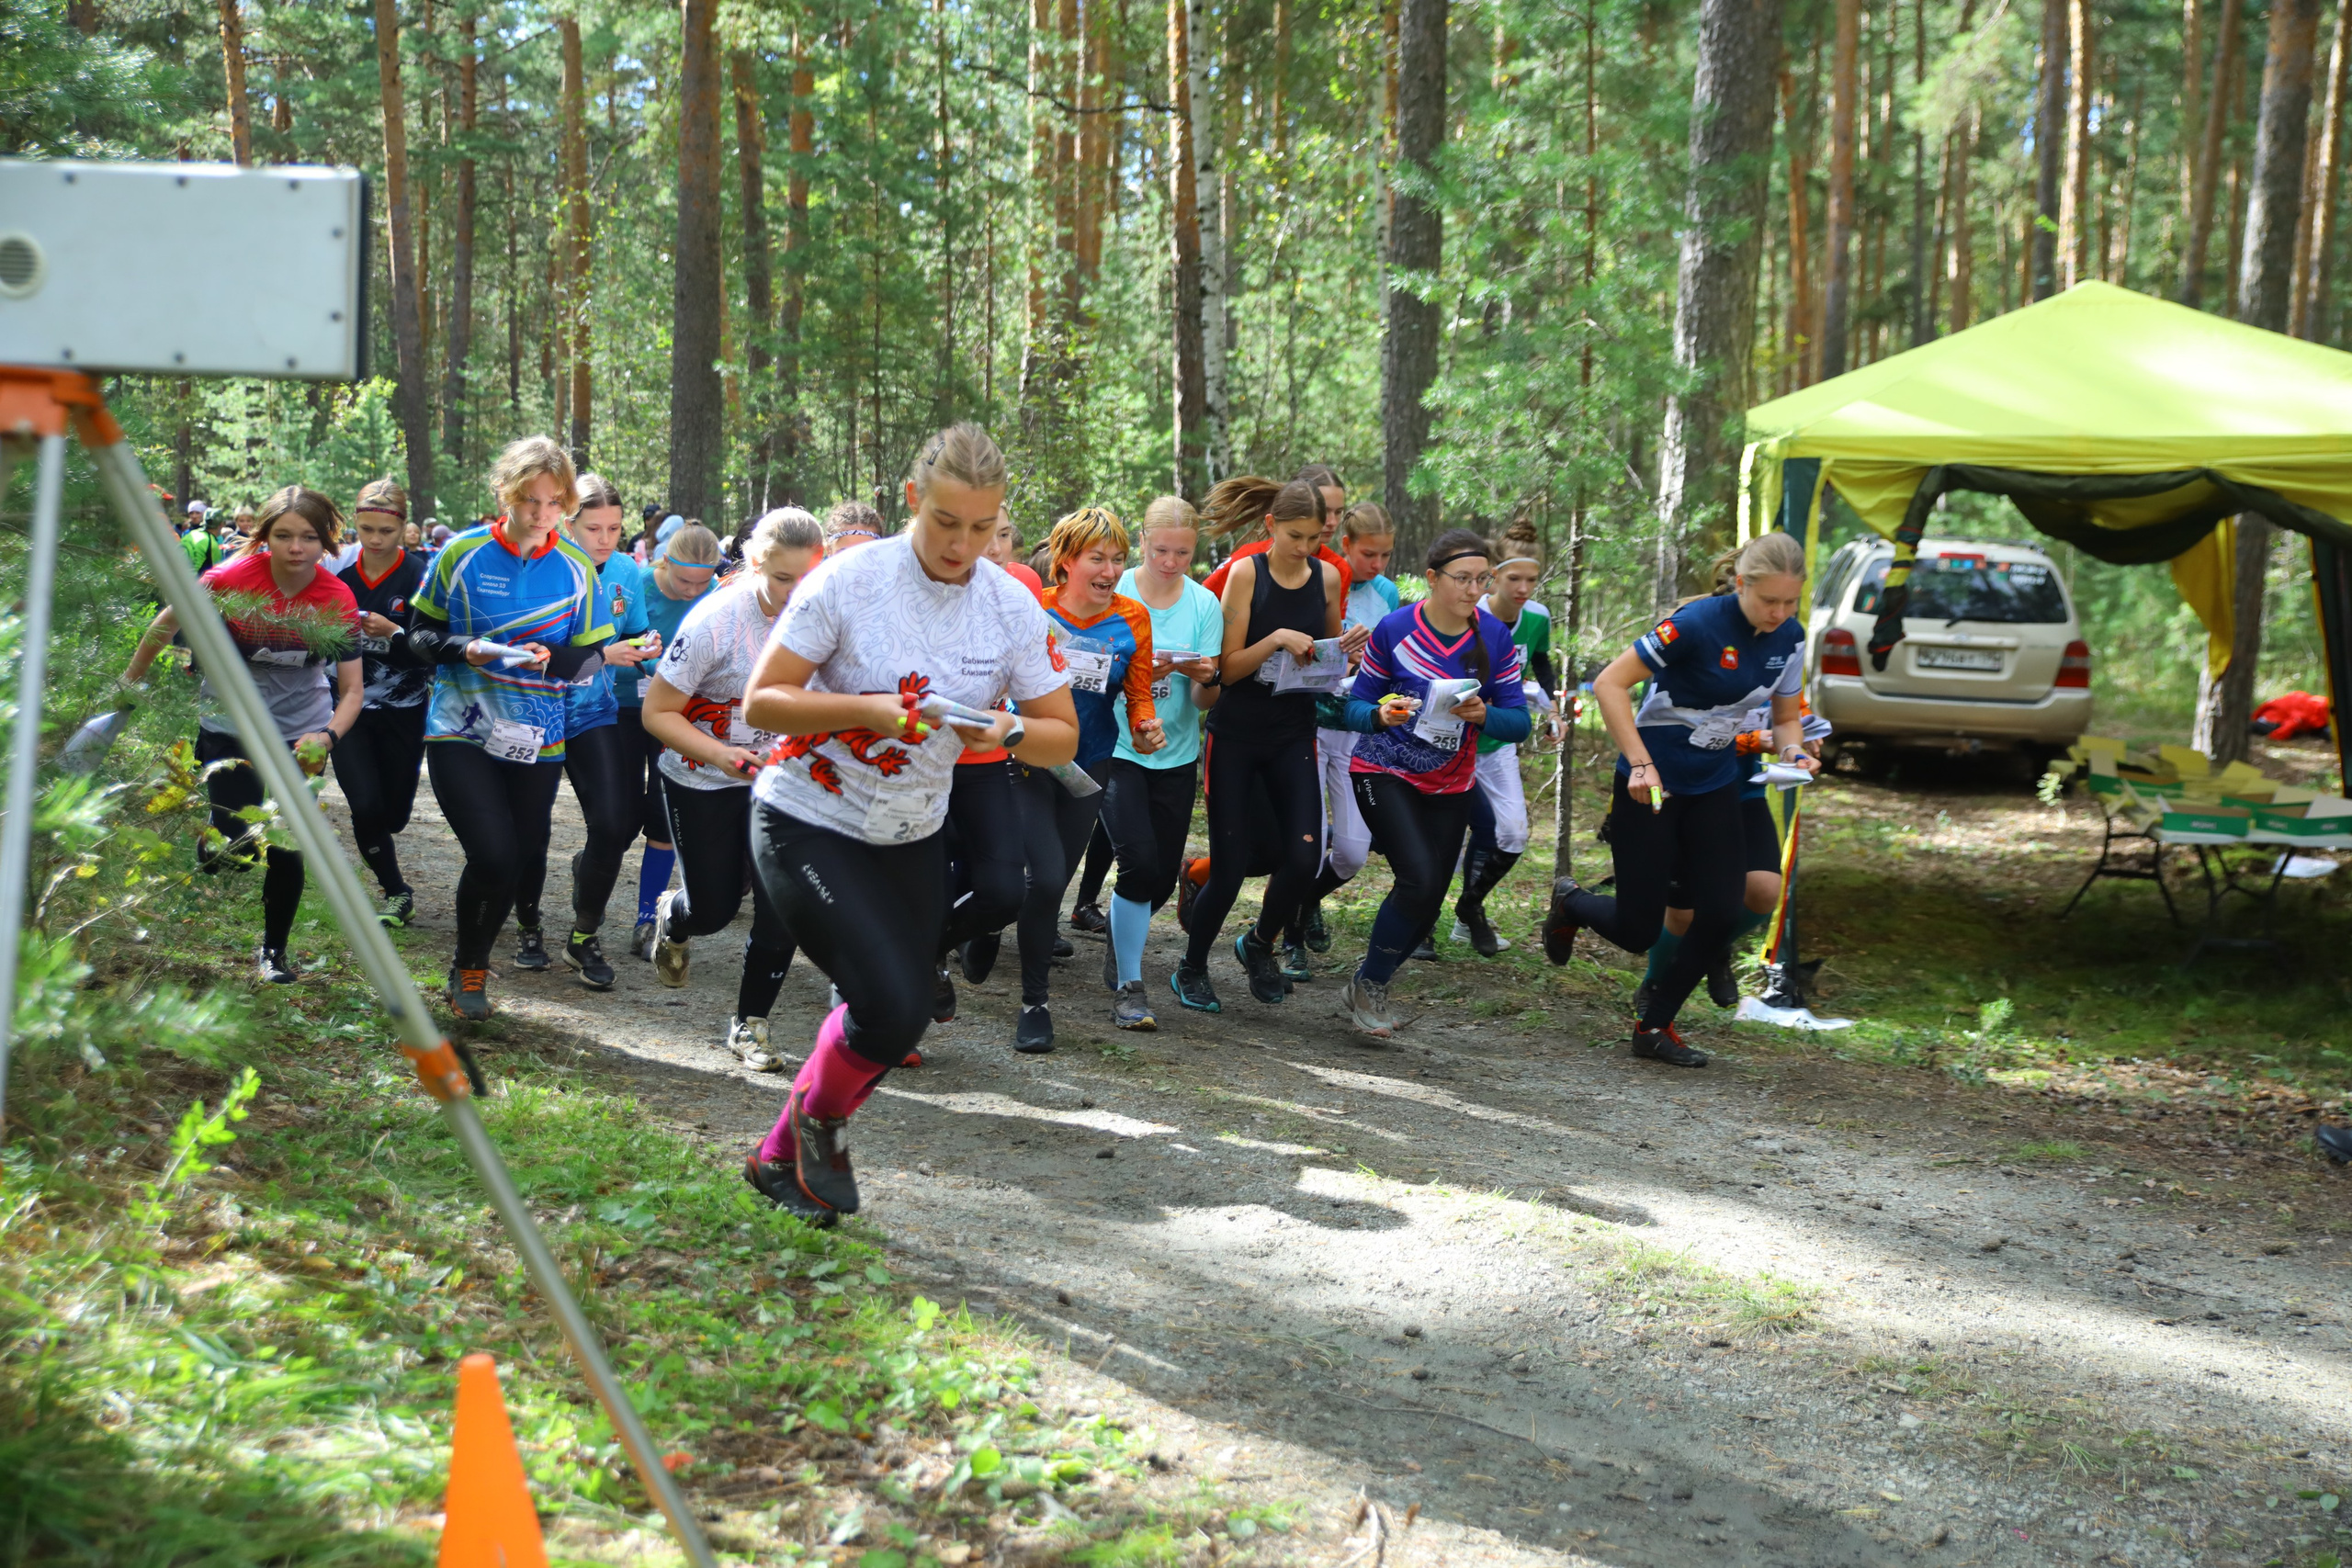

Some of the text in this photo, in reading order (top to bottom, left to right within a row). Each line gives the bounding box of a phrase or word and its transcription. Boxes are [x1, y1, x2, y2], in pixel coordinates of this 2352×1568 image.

[477, 586, 511, 597] Екатеринбург
[1072, 675, 1102, 692] 255
[1432, 735, 1458, 750] 258
[504, 745, 536, 761] 252
